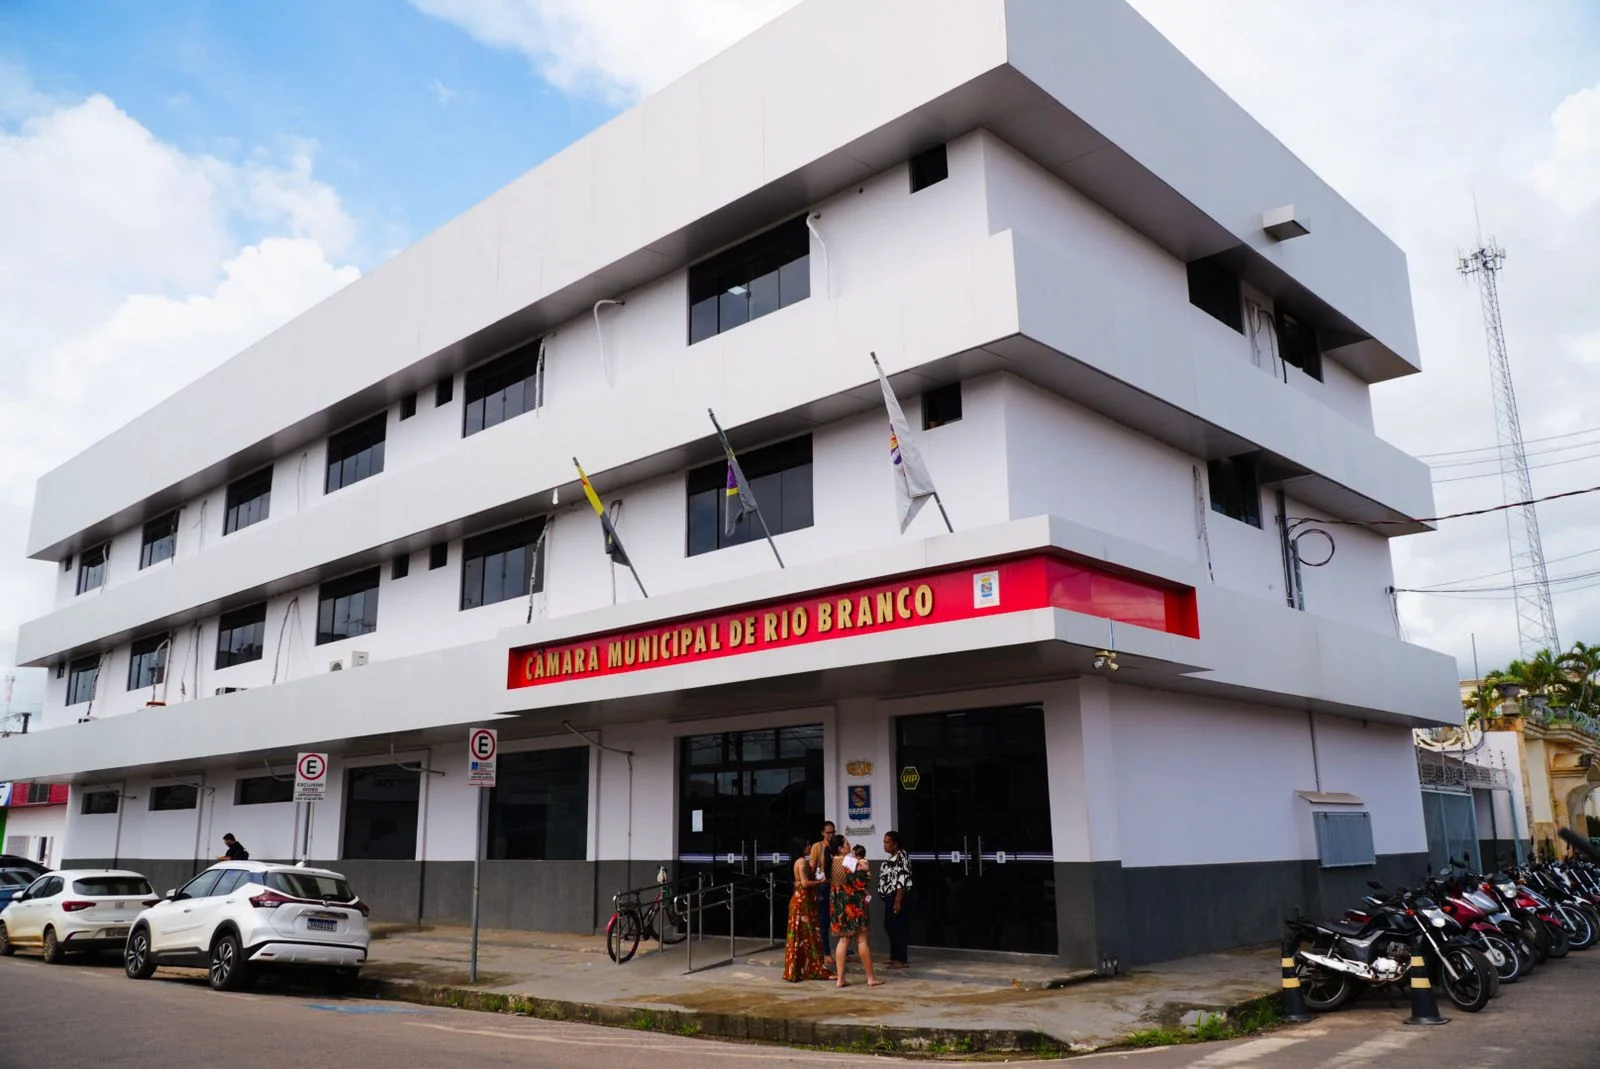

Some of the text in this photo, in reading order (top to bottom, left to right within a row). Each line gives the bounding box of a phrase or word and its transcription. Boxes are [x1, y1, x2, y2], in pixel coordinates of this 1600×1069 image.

[525, 584, 934, 681] CÂMARA MUNICIPAL DE RIO BRANCO
[478, 735, 488, 754] E
[306, 760, 317, 774] E
[903, 774, 918, 783] VIP
